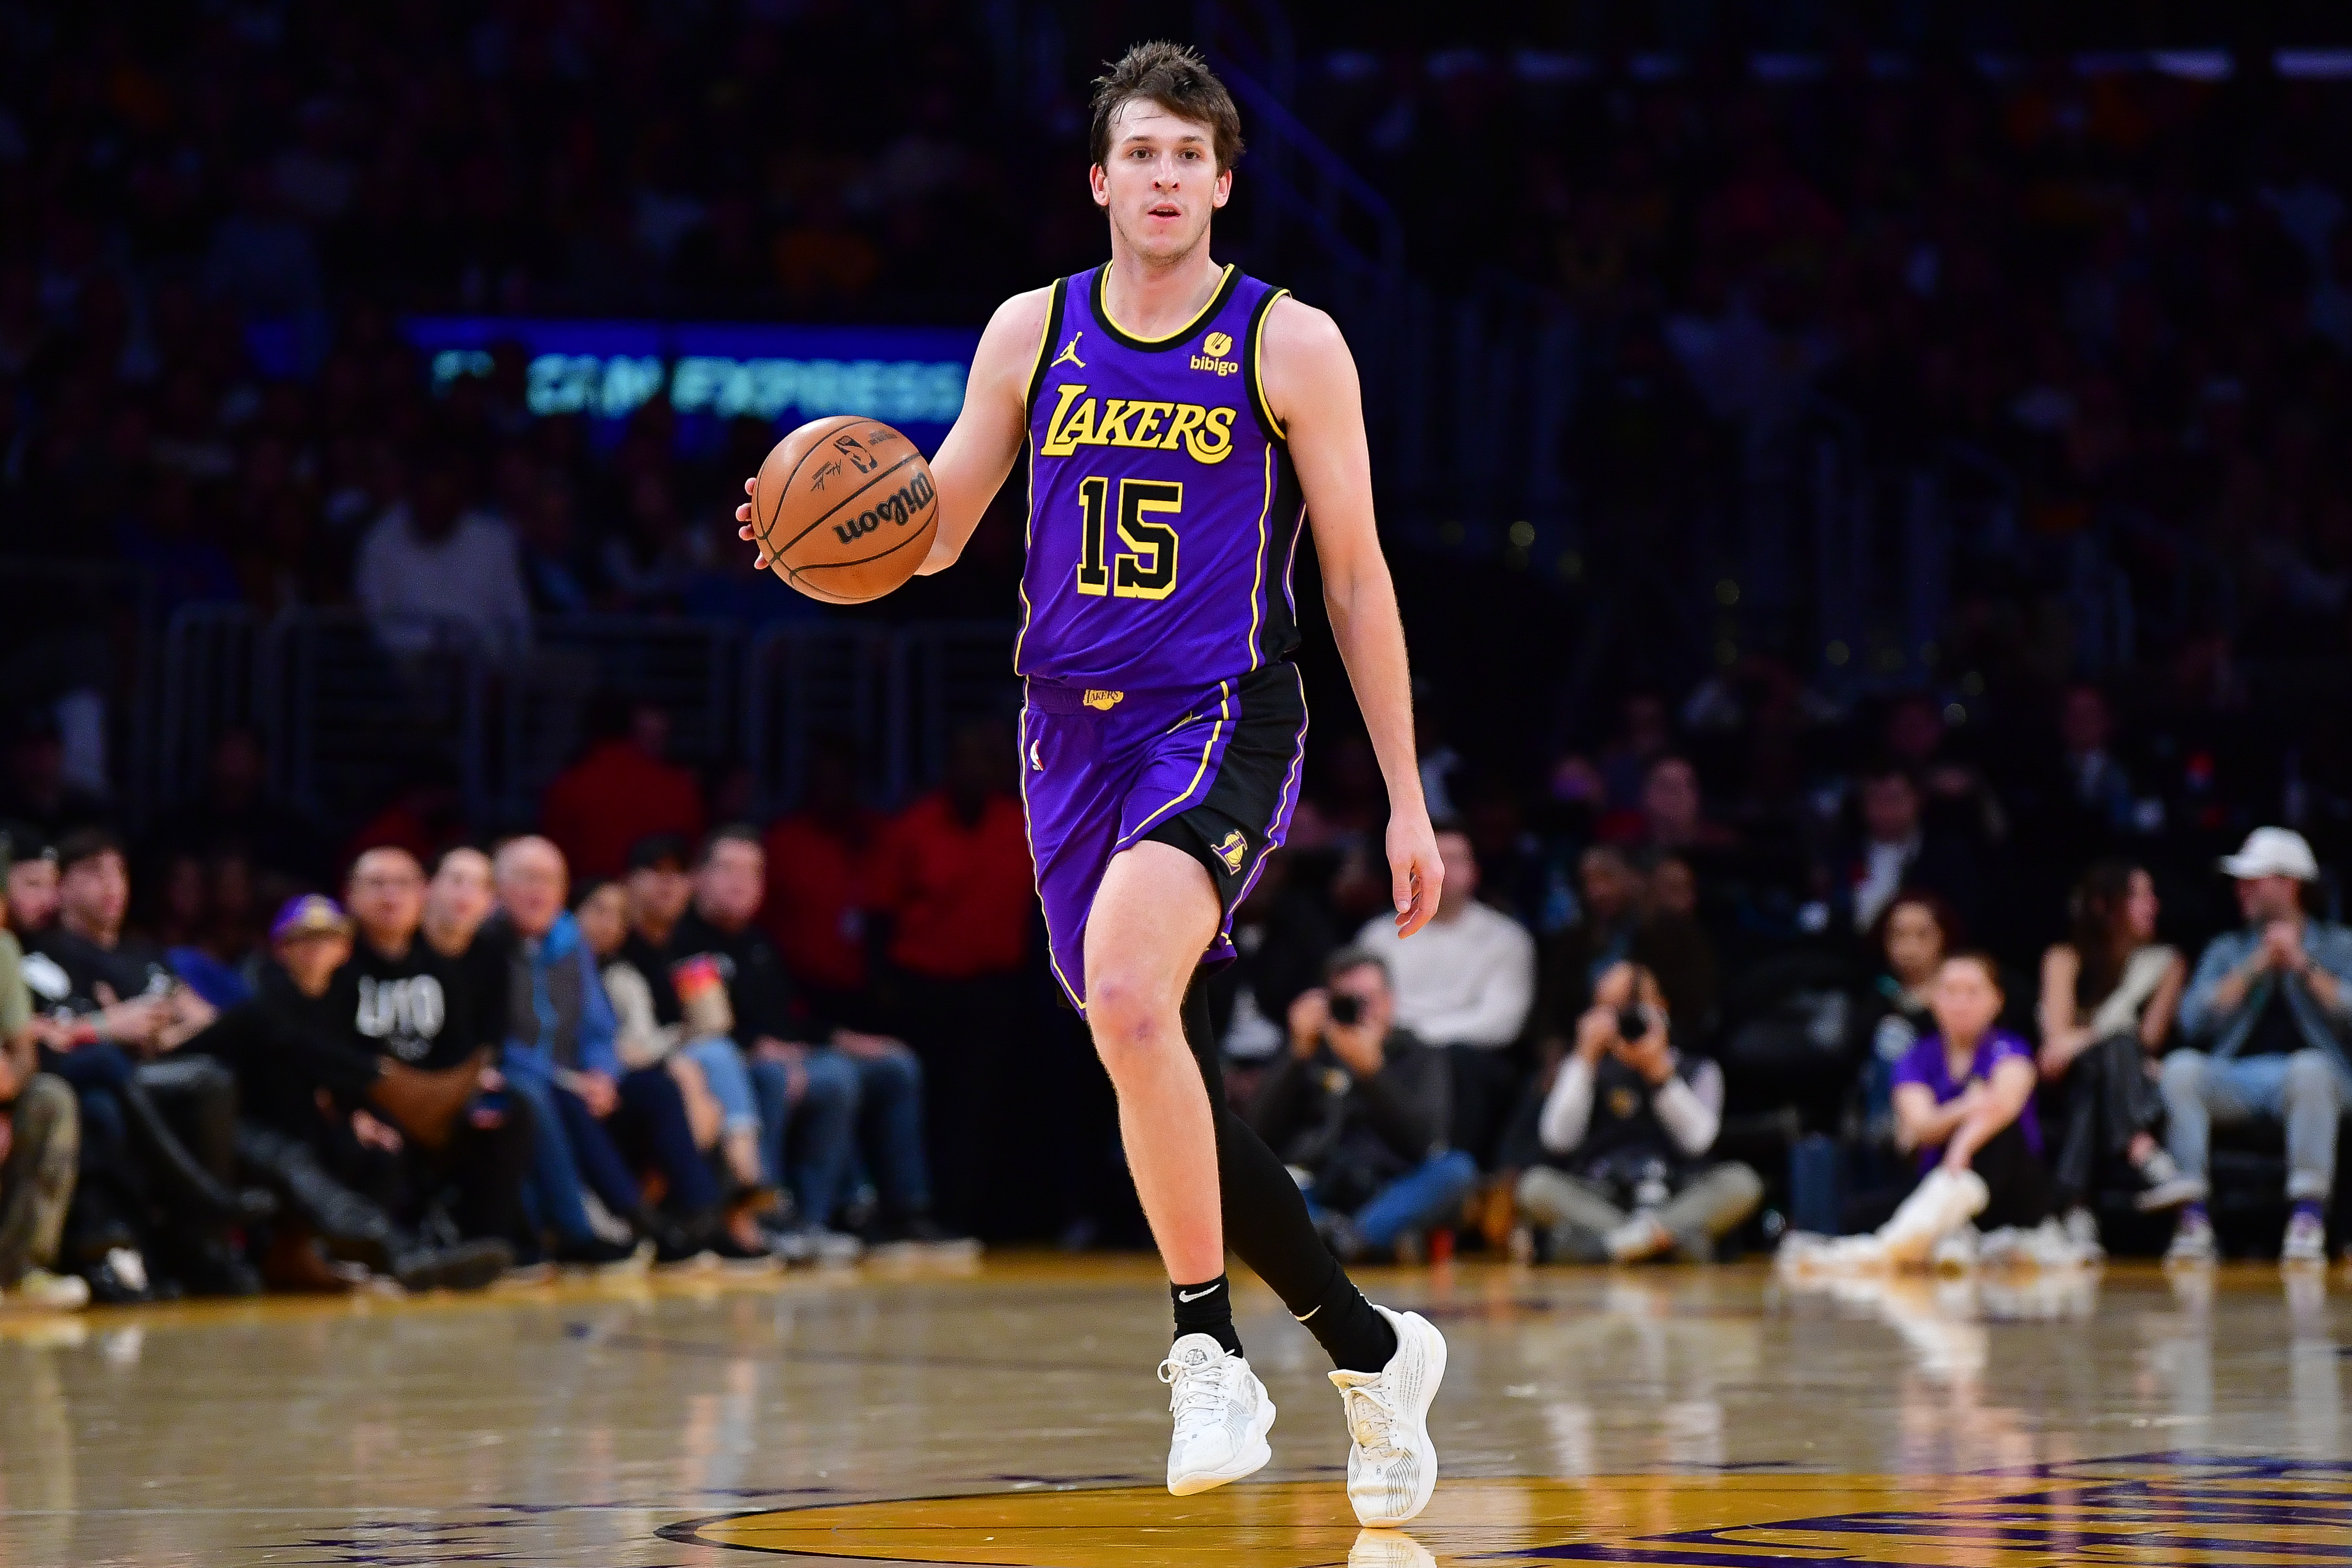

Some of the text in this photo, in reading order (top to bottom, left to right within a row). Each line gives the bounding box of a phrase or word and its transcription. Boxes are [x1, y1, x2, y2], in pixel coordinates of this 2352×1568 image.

[1190, 355, 1239, 377] bibigo
[1040, 383, 1237, 464] LAKERS
[831, 471, 934, 544] Wilson
[1077, 476, 1183, 600] 15
